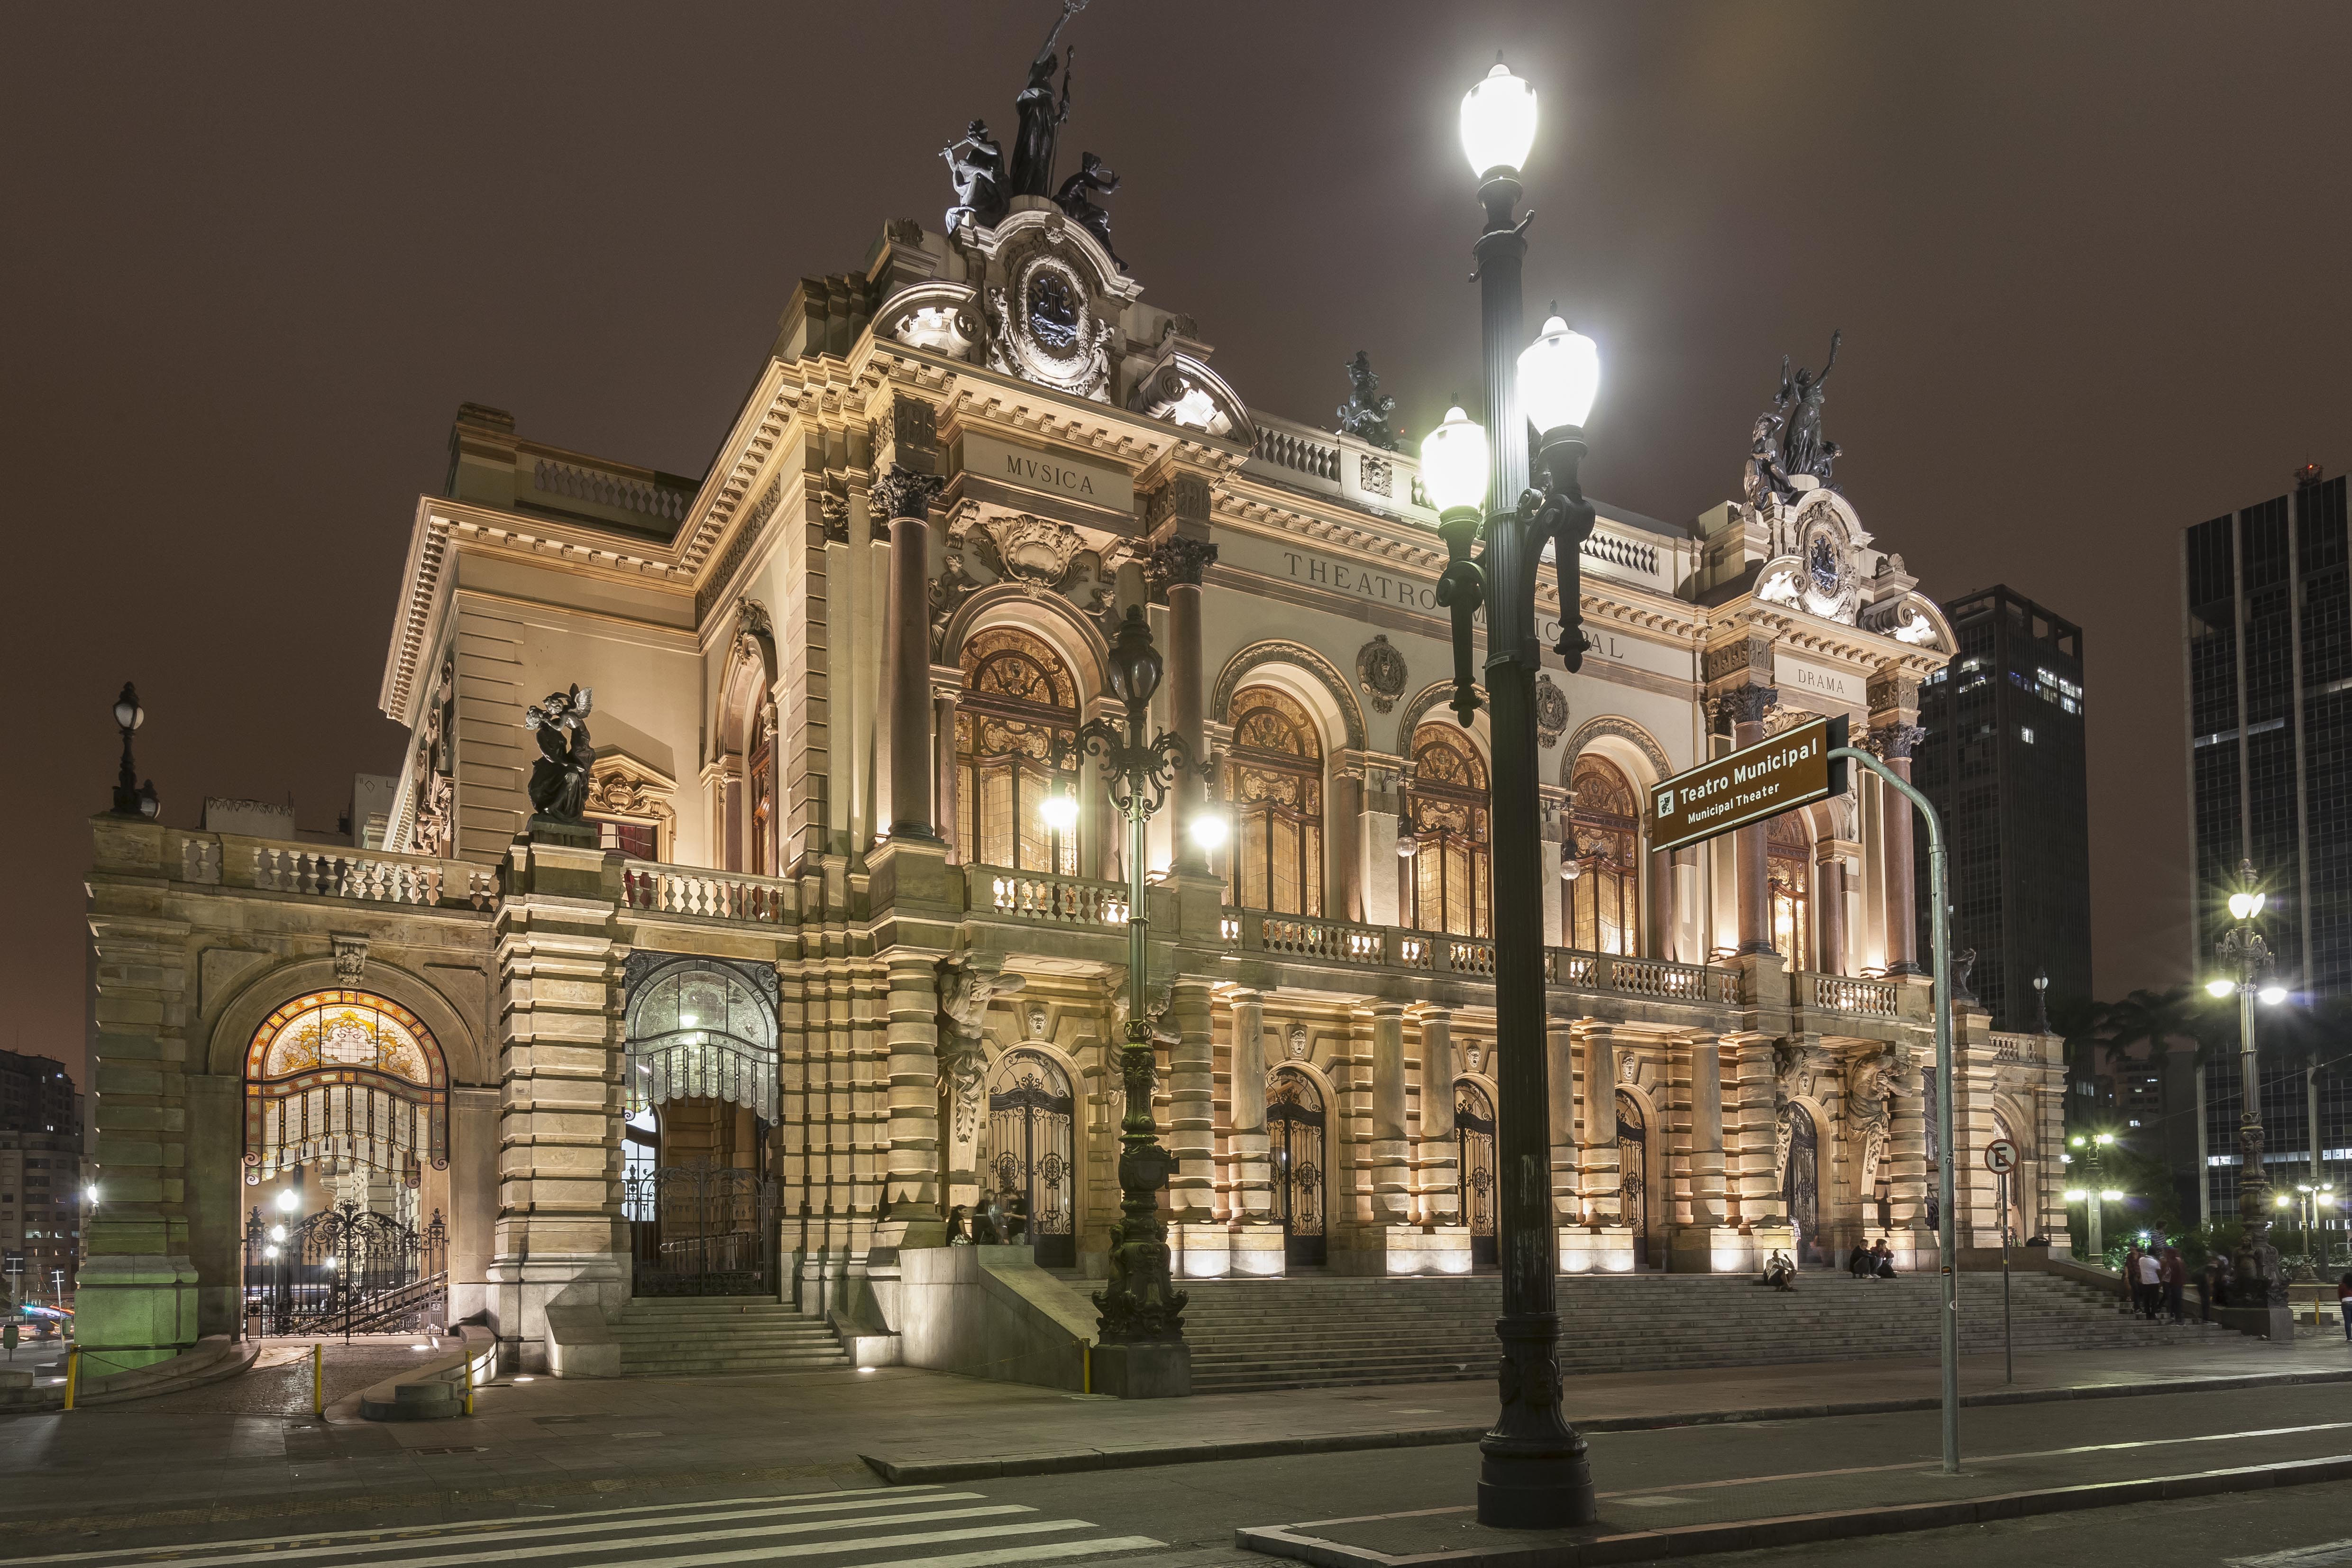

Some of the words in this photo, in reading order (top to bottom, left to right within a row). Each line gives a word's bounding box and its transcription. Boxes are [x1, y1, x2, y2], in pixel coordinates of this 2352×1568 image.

[1007, 454, 1094, 495] MVSICA
[1284, 552, 1437, 610] THEATRO
[1798, 669, 1844, 694] DRAMA
[1680, 776, 1728, 804] Teatro
[1734, 737, 1816, 785] Municipal
[1688, 798, 1733, 824] Municipal
[1736, 783, 1779, 806] Theater
[1995, 1146, 2007, 1167] E
